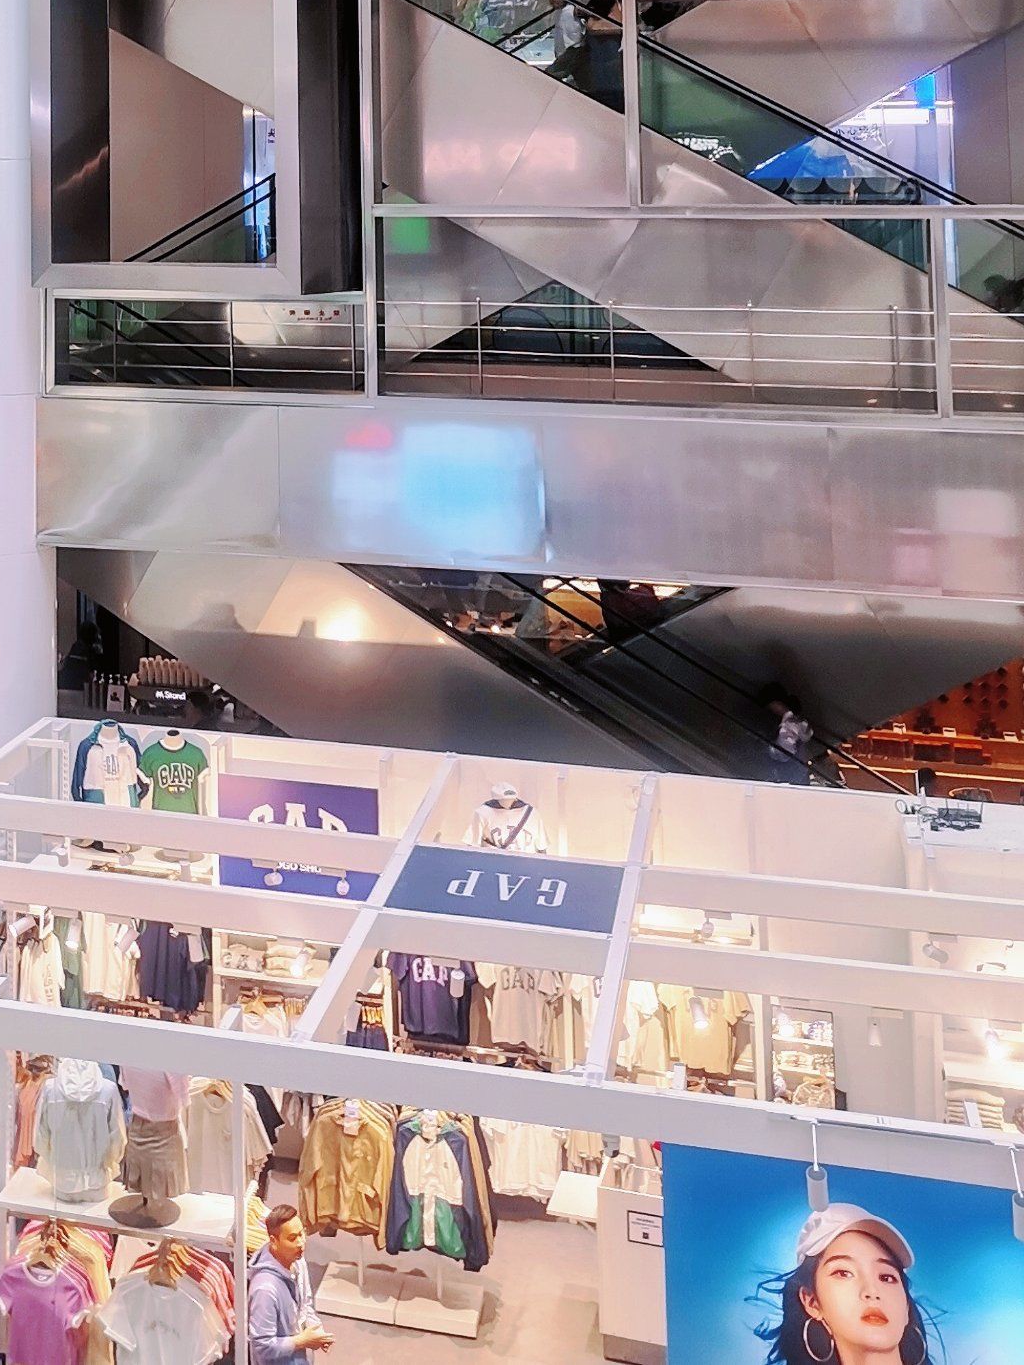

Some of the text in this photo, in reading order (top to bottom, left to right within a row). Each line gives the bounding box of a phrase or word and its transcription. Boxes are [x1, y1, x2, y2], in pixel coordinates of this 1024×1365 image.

[164, 690, 187, 701] Stand
[157, 761, 195, 790] GAP
[446, 868, 568, 908] GAP
[411, 957, 450, 987] GAP
[500, 966, 535, 992] GAP
